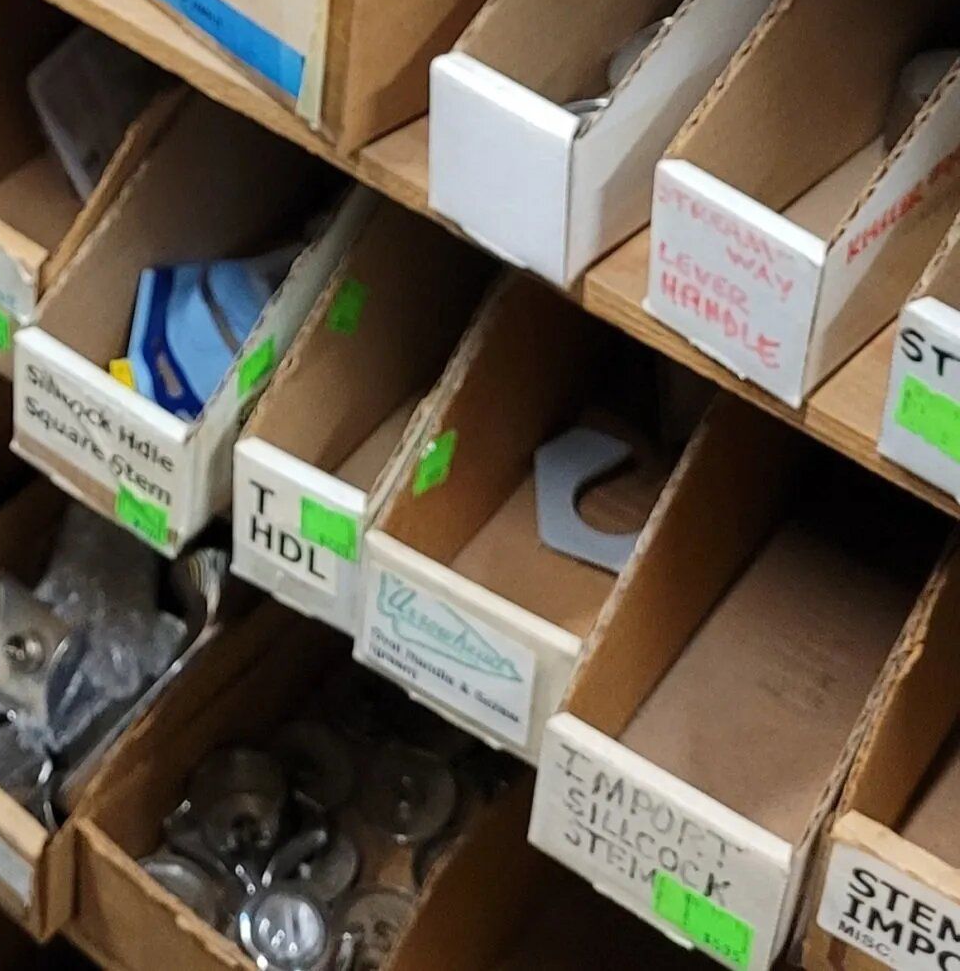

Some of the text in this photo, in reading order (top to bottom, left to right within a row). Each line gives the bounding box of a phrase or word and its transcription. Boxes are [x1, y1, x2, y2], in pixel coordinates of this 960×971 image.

[660, 271, 781, 370] HANDLE
[24, 396, 172, 506] Square Stem
[248, 479, 275, 516] T
[250, 515, 327, 580] HDL
[564, 787, 732, 908] SILLCOCK
